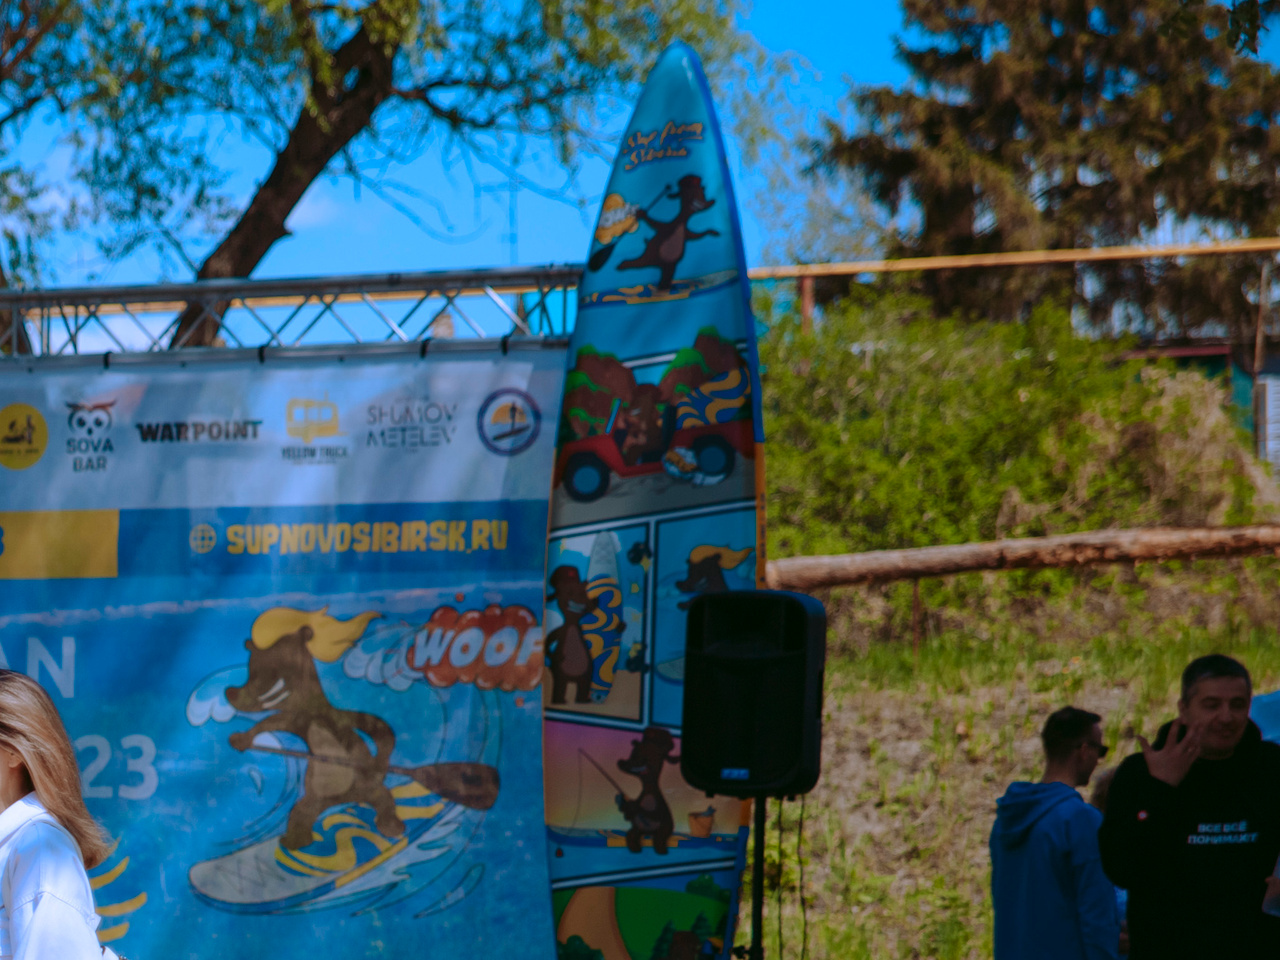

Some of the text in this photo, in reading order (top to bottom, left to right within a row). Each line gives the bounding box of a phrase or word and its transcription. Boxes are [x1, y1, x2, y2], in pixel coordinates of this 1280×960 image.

[137, 420, 264, 443] WARPOINT
[66, 437, 114, 454] SOVA
[73, 457, 107, 472] BAR
[226, 520, 509, 555] SUPNOVOSIBIRSK.RU
[1188, 832, 1257, 844] ПОНИМАЮТ
